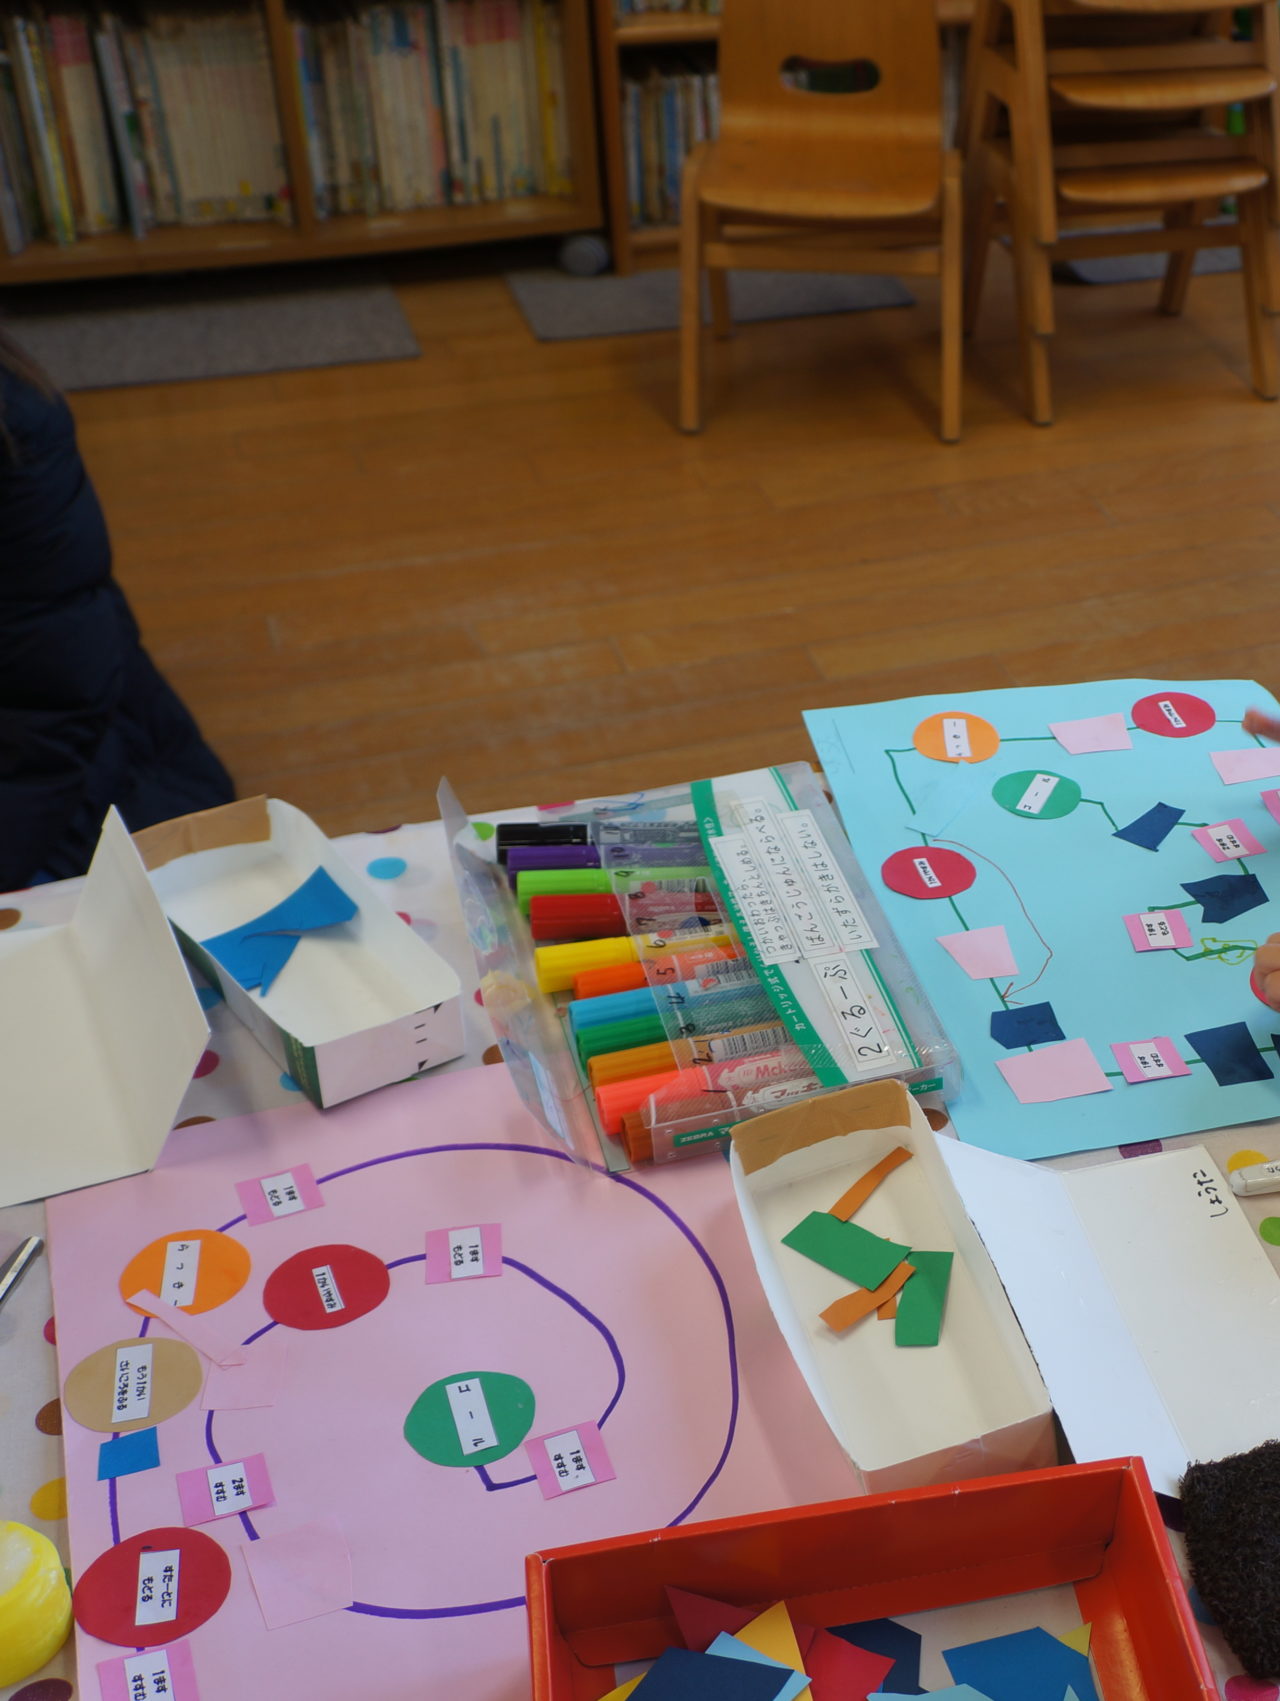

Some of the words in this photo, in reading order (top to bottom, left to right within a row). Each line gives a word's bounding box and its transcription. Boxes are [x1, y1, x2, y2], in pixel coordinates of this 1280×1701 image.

[1023, 777, 1050, 811] ゴール
[614, 870, 634, 878] 9
[750, 808, 825, 947] ばんごうじゅんにならべる。
[798, 823, 863, 941] いたずらがきはしない。
[628, 891, 645, 900] 8
[737, 843, 793, 952] きゃっぷはきちんとしめる。
[635, 917, 656, 926] 7
[742, 878, 778, 955] つかいおわったら、
[646, 939, 667, 949] 6
[656, 967, 675, 976] 5
[824, 964, 883, 1057] 2ぐるーぷ
[680, 1131, 714, 1143] ZEBRA
[268, 1189, 282, 1207] もどる
[283, 1184, 298, 1201] 1ます
[1193, 1168, 1229, 1218] しょうた
[453, 1245, 464, 1266] もどる
[468, 1244, 481, 1263] 1ます
[172, 1244, 190, 1307] らっきー
[315, 1271, 337, 1309] 1かいやすみ
[116, 1360, 130, 1411] さいころをふる
[136, 1364, 148, 1401] もう1かい
[458, 1384, 485, 1447] ゴール
[553, 1453, 569, 1478] すすむ
[569, 1449, 586, 1471] 1ます
[214, 1481, 227, 1503] すすむ
[231, 1477, 246, 1497] 2ます
[141, 1576, 154, 1603] もどる
[161, 1565, 174, 1608] すたーとに
[152, 1669, 168, 1694] 1ます
